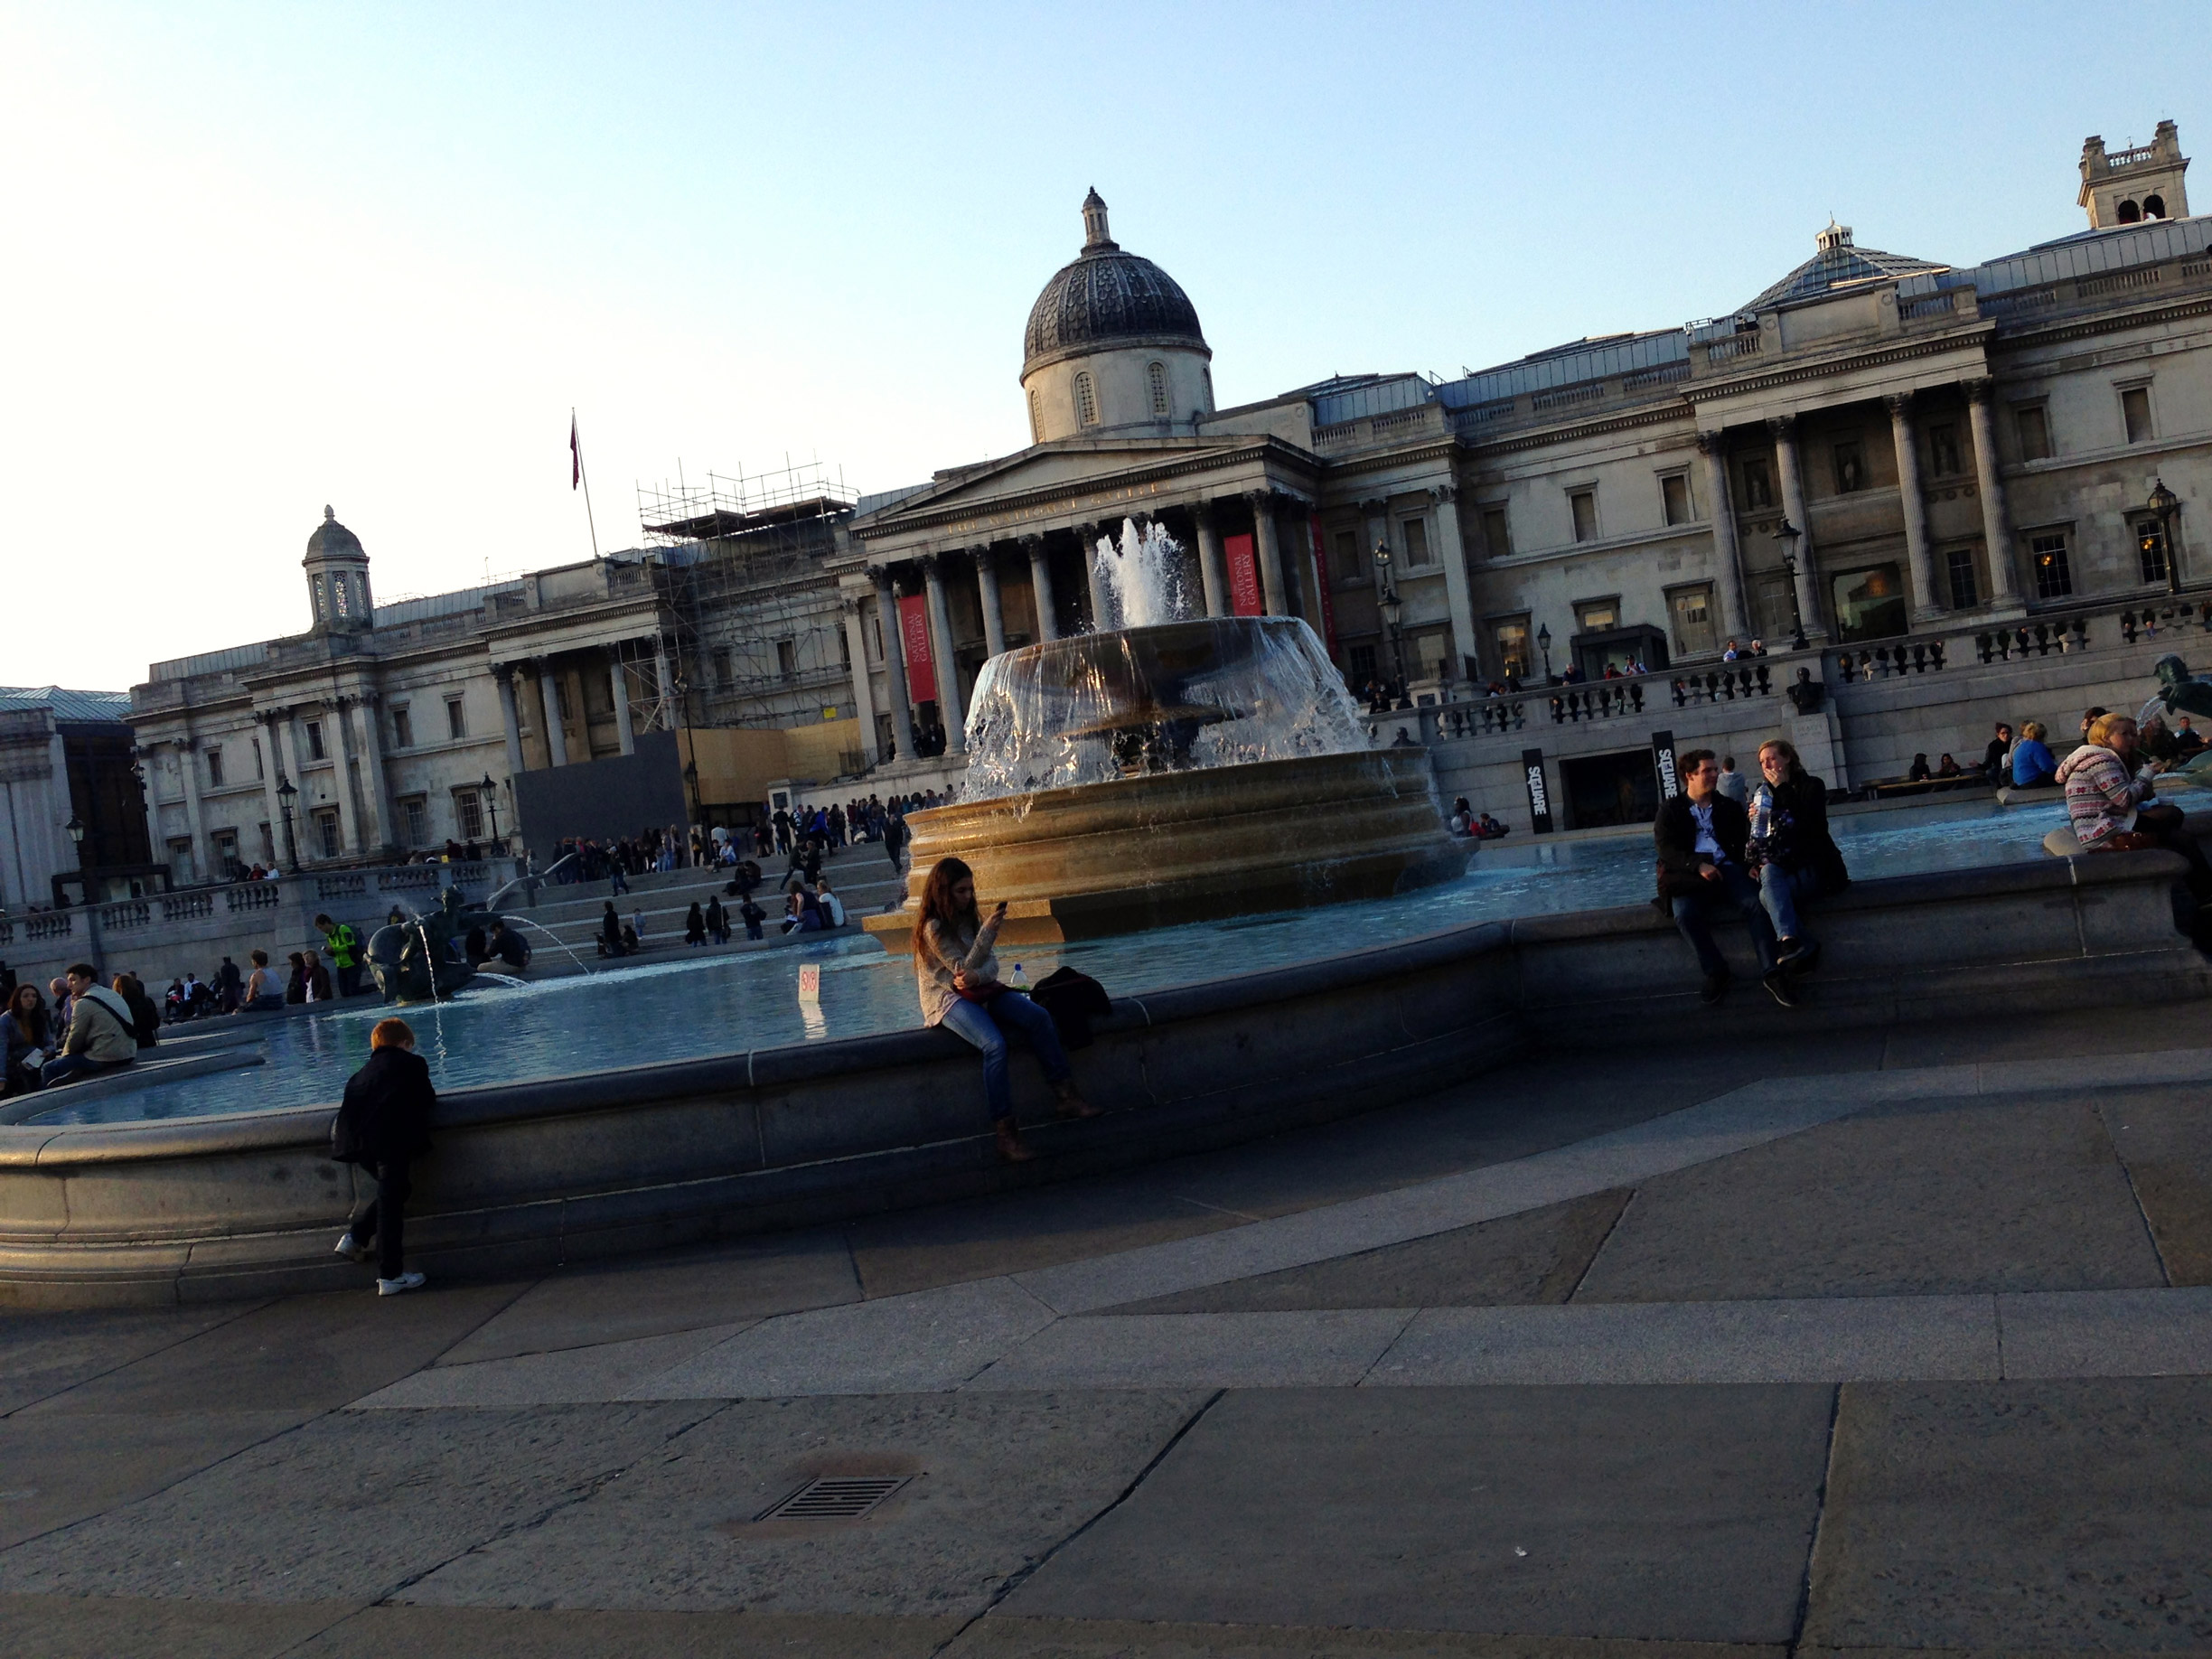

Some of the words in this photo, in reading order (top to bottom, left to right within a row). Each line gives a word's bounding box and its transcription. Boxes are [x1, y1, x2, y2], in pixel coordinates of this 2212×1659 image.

[948, 520, 978, 534] THE
[989, 499, 1077, 526] NATIONAL
[1091, 483, 1172, 505] GALLERY
[1234, 555, 1247, 606] NATIONAL
[1242, 554, 1257, 606] GALLERY
[907, 614, 920, 662] NATIONAL
[914, 614, 928, 662] GALLERY
[1527, 765, 1547, 816] SQUARE
[1657, 748, 1678, 800] SQUARE
